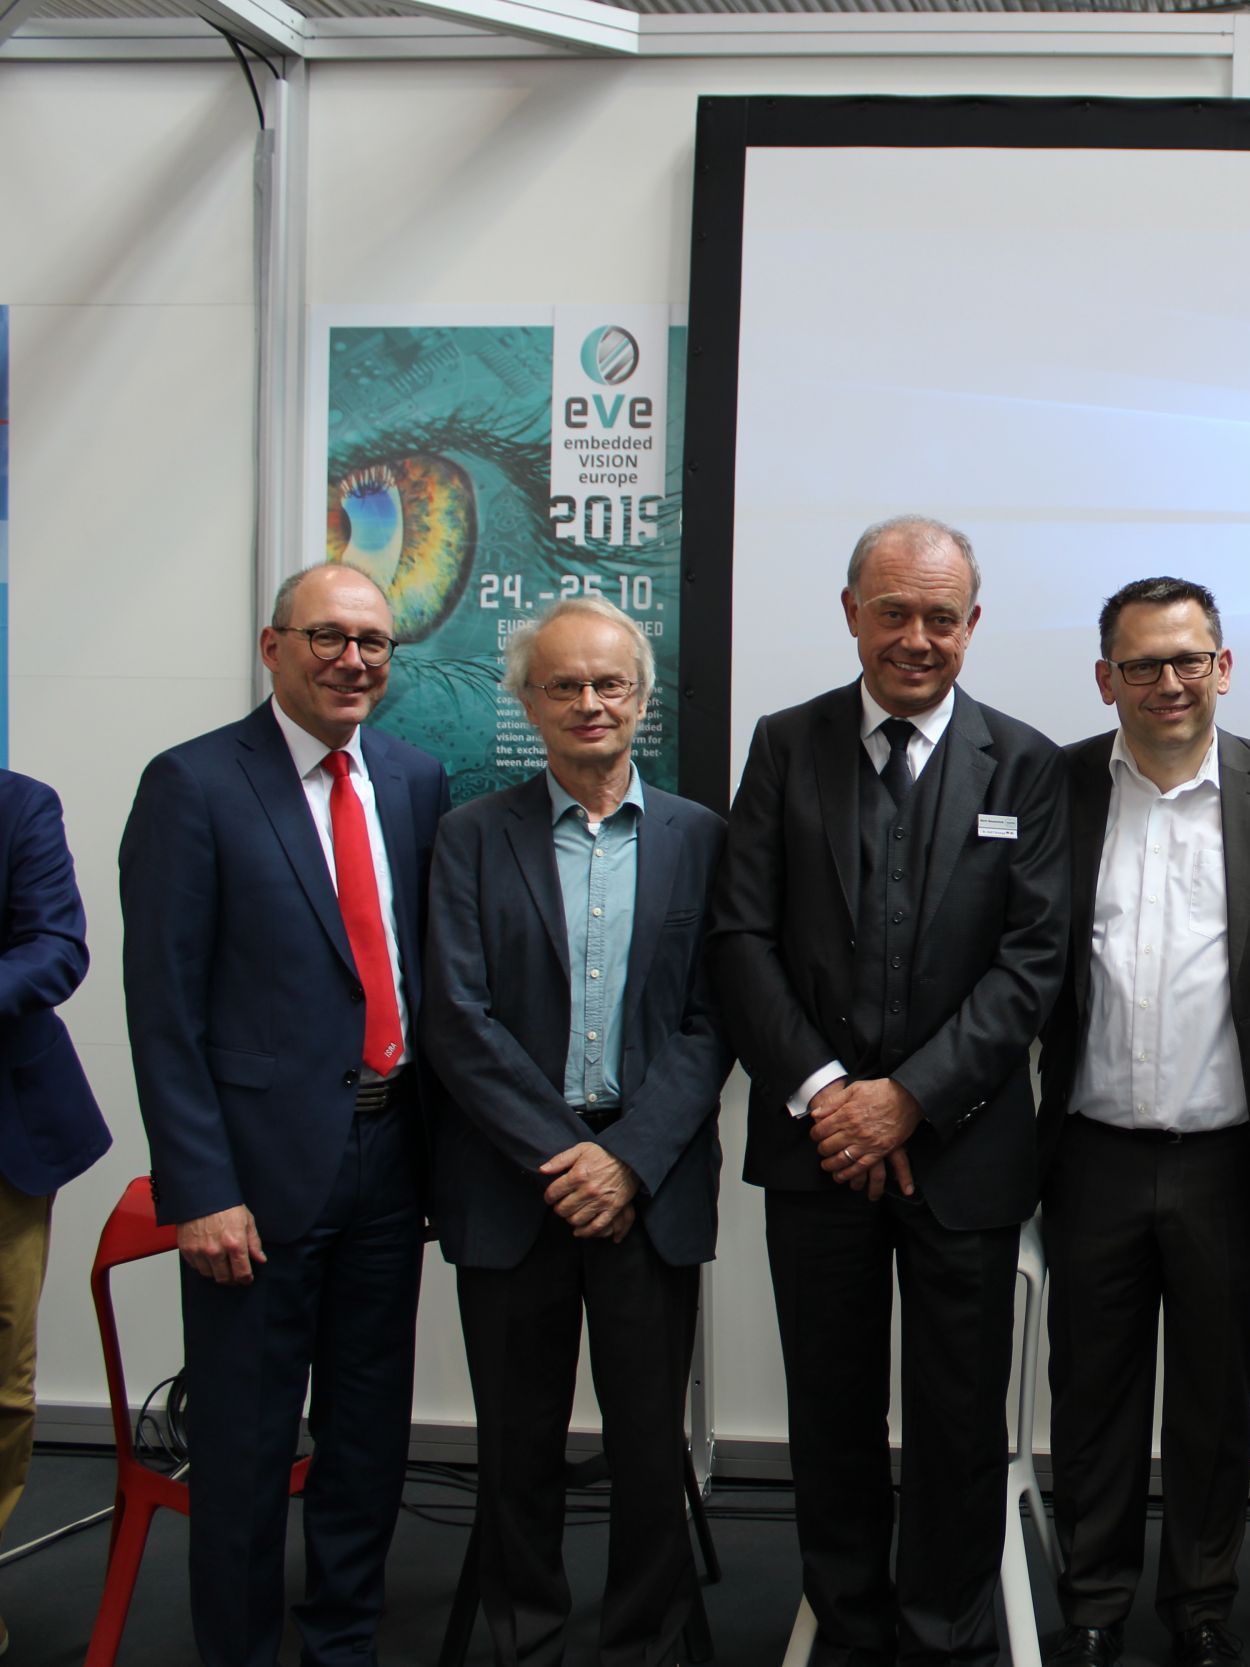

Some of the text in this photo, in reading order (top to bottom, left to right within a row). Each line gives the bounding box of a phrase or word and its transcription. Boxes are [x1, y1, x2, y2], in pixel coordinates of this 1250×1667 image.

[564, 436, 653, 450] embedded
[579, 454, 638, 469] VISION
[579, 472, 638, 488] europe
[550, 495, 665, 545] 2019
[496, 709, 663, 720] ware pli-
[496, 733, 524, 742] vision
[648, 735, 663, 744] for
[496, 746, 512, 754] the
[643, 748, 663, 757] bet-
[496, 759, 522, 767] ween
